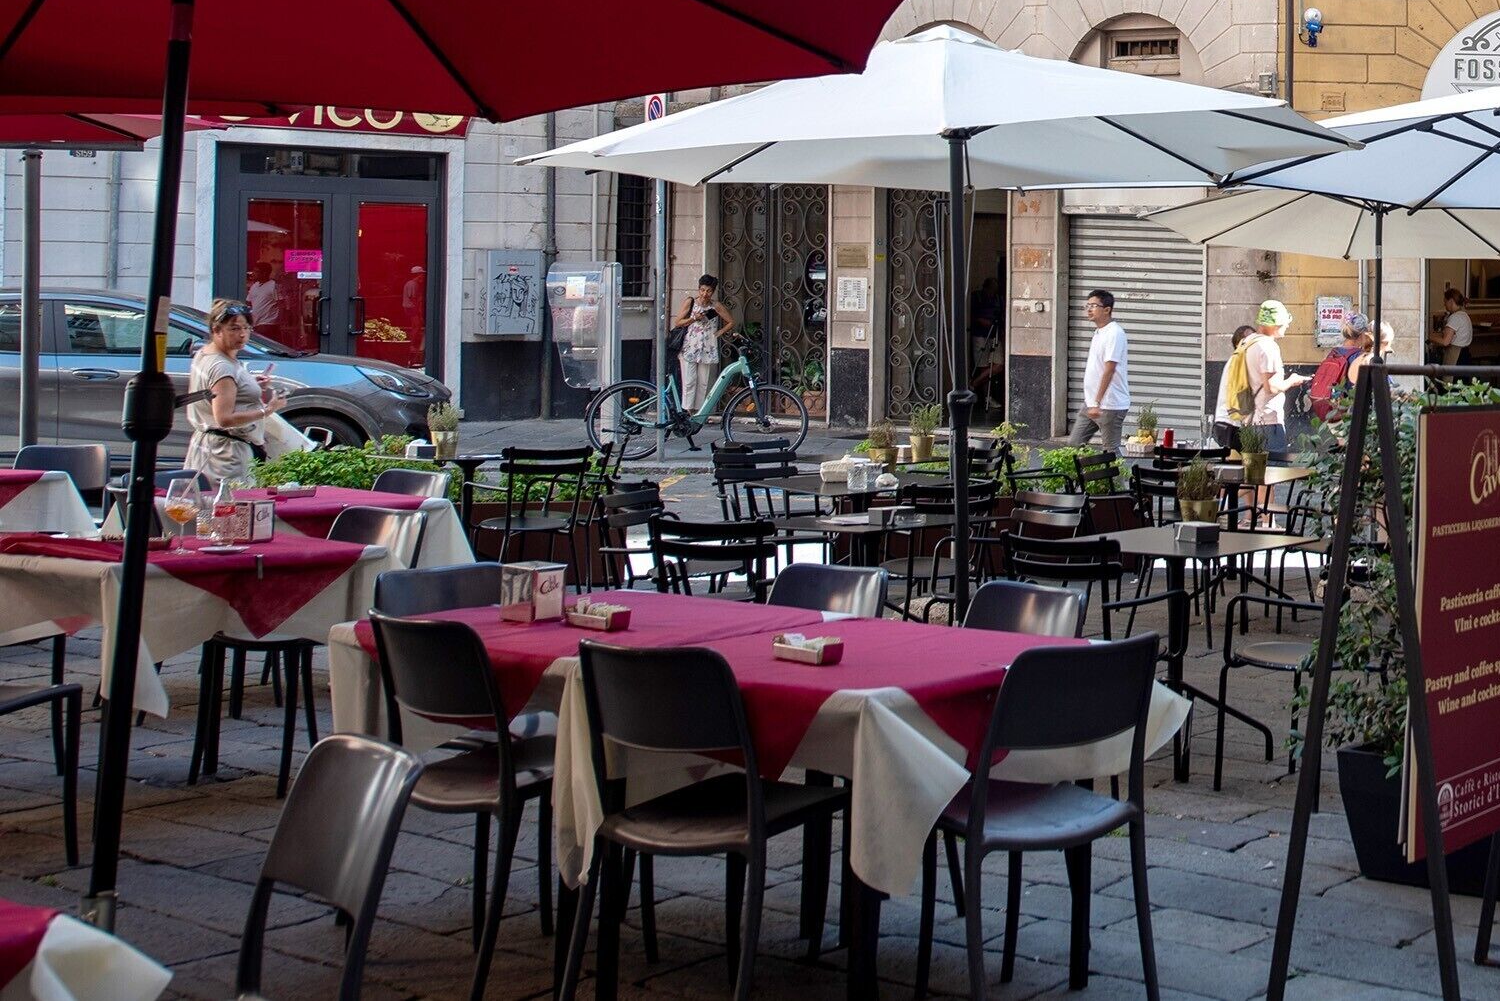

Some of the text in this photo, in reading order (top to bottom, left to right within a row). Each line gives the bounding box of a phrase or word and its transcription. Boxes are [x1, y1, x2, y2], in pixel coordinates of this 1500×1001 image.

[1432, 521, 1471, 537] PASTICCERIA
[1440, 588, 1484, 612] Pasticceria
[1474, 619, 1479, 629] e
[1425, 674, 1453, 693] Pastry
[1454, 666, 1470, 684] and
[1471, 660, 1494, 679] coffee
[1438, 697, 1460, 715] Wine
[1461, 689, 1477, 708] and
[1454, 778, 1475, 798] Caffè
[1477, 780, 1481, 789] e
[1454, 791, 1484, 817] Storici
